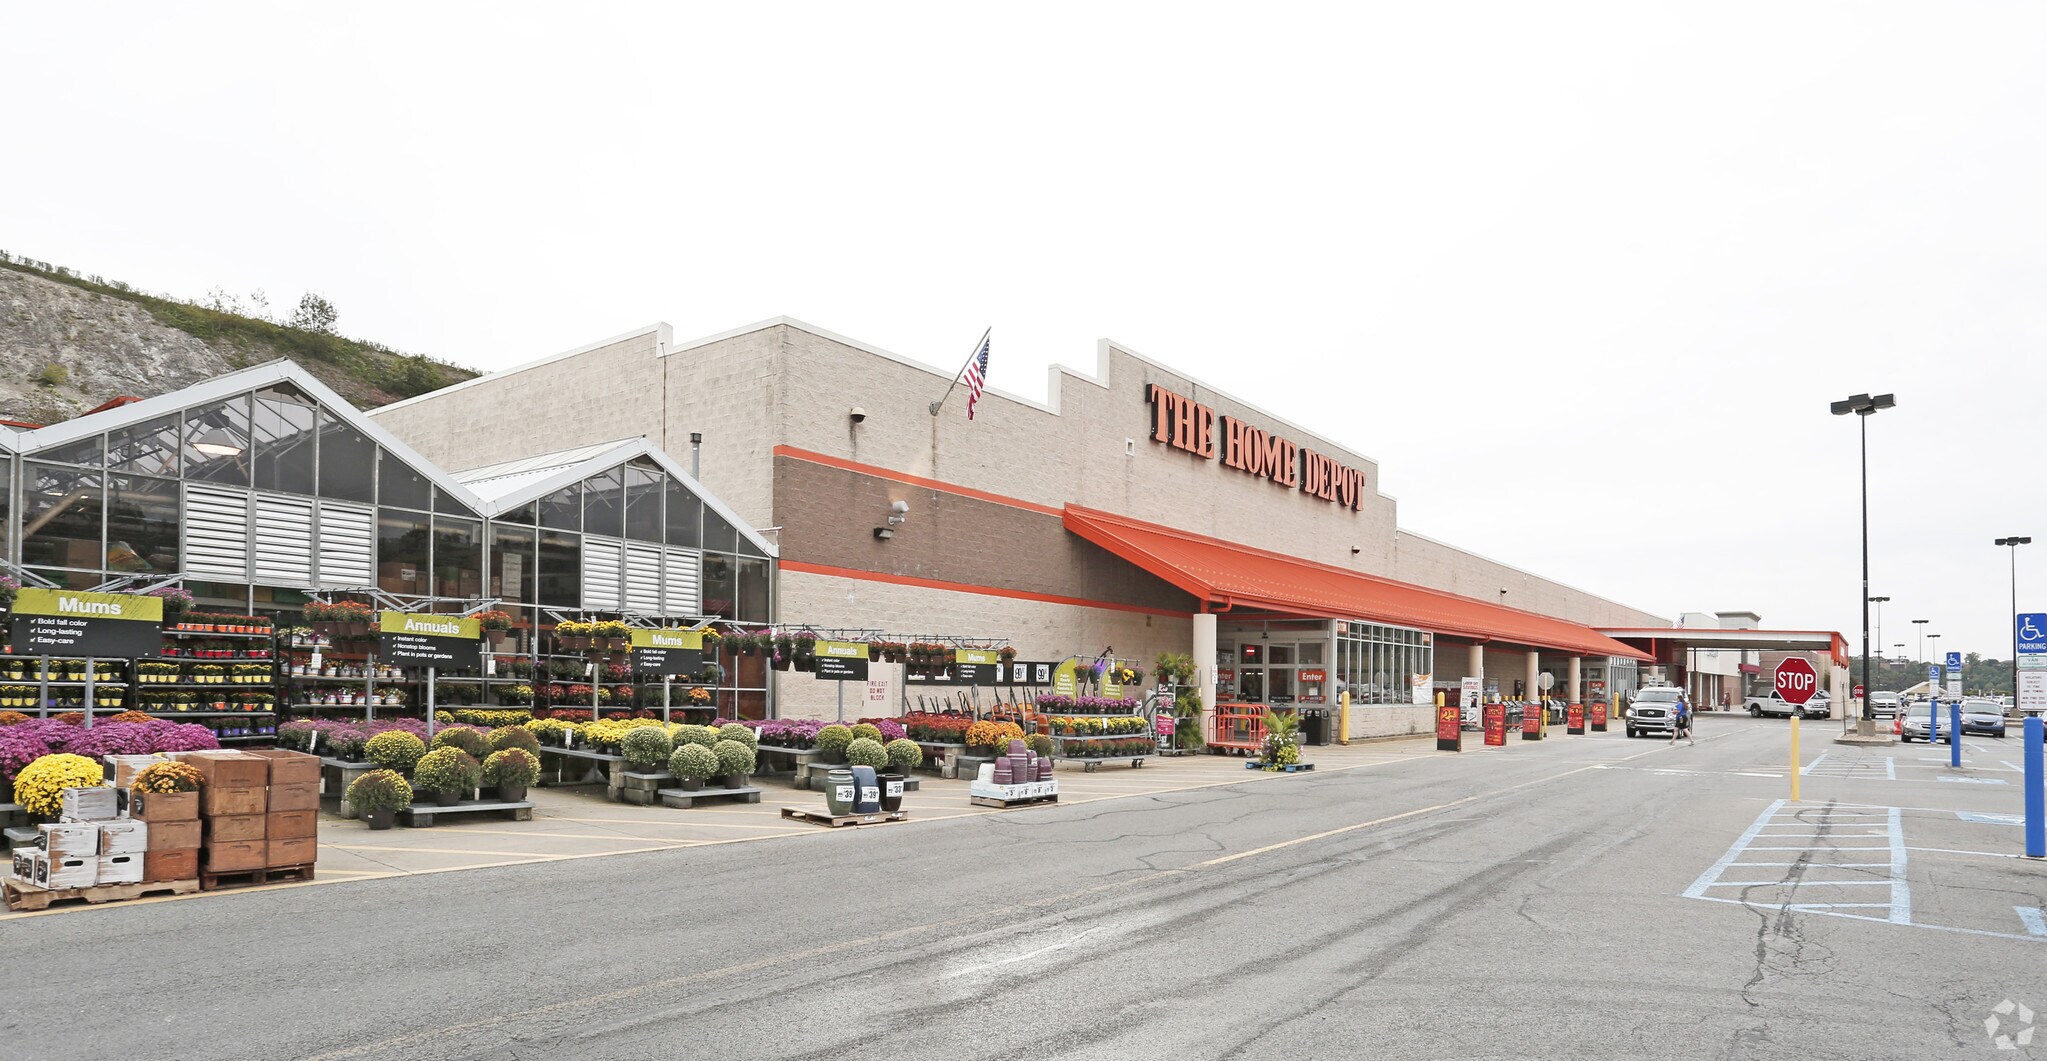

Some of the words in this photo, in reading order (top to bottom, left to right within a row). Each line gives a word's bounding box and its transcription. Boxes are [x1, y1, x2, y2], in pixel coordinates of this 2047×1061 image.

[1146, 384, 1214, 459] THE
[1220, 415, 1297, 488] HOME
[1300, 448, 1366, 511] DEPOT
[58, 597, 122, 615] Mums
[38, 627, 83, 636] Long-lasting
[404, 618, 460, 634] Annuals
[38, 637, 74, 645] Easy-care
[652, 634, 683, 646] Mums
[828, 646, 857, 656] Annuals
[967, 653, 986, 662] Mums
[1778, 671, 1814, 690] STOP
